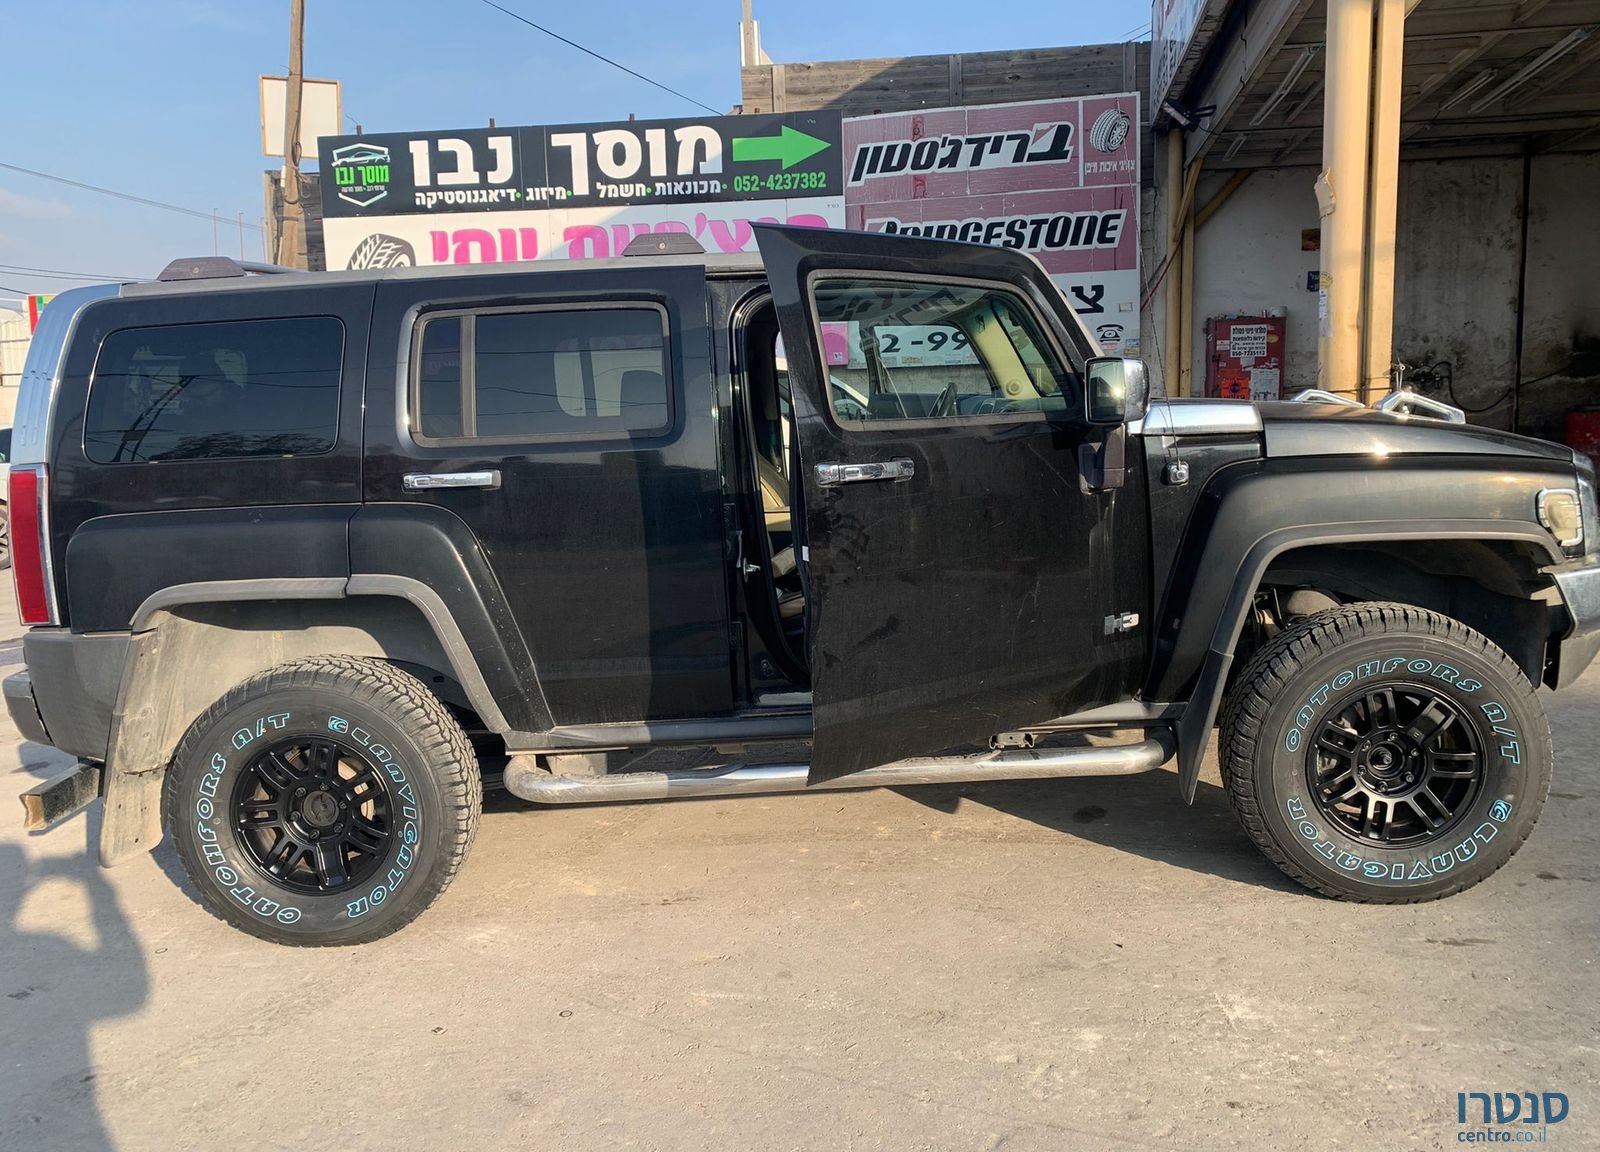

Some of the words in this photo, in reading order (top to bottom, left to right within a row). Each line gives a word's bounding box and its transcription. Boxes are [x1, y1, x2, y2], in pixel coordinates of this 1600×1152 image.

[409, 135, 514, 187] נבו
[551, 125, 723, 196] מוסך
[335, 166, 355, 185] נבו
[357, 165, 390, 186] מוסך
[733, 171, 827, 192] 052-4237382
[415, 187, 517, 209] דיאגנוסטיקה
[526, 186, 567, 201] מיזוג
[596, 182, 647, 198] חשמל
[655, 179, 721, 197] מכונאות
[880, 213, 1123, 250] GESTONE
